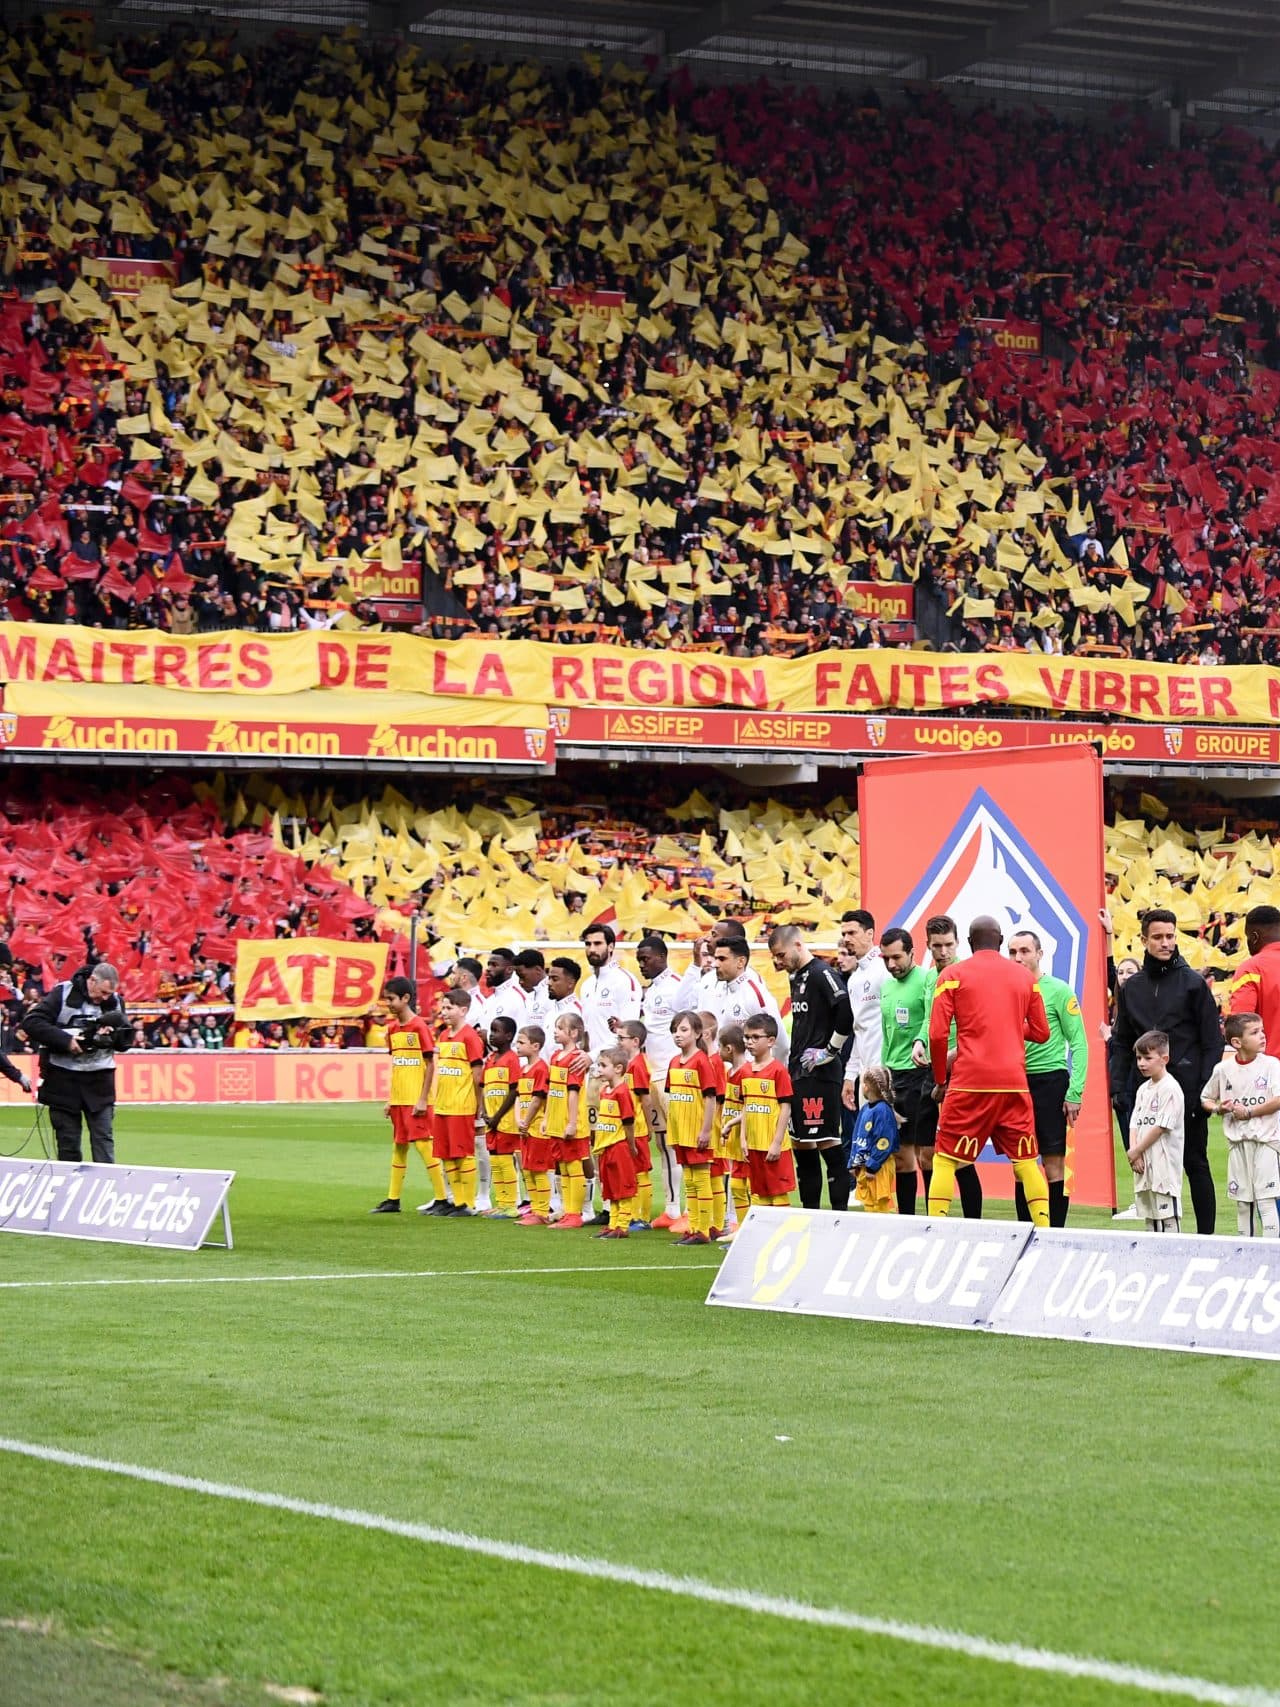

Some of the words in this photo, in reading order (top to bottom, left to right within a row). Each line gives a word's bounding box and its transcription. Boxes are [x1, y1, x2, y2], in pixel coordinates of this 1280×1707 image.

[994, 330, 1038, 349] chan
[0, 634, 272, 689] MAITRES
[317, 642, 392, 690] DE
[433, 651, 512, 698] LA
[815, 663, 1010, 706] FAITES
[1038, 667, 1239, 718] VIBRER
[42, 716, 178, 751] Auchan
[207, 720, 340, 755] Auchan
[367, 723, 497, 759] Auchan
[914, 724, 1002, 751] waigéo
[1195, 736, 1270, 757] GROUPE
[242, 954, 376, 1009] ATB
[116, 1063, 197, 1100] LENS
[296, 1063, 344, 1098] RC
[588, 1107, 597, 1124] 8
[651, 1109, 660, 1126] 2
[78, 1178, 143, 1228] Uber
[133, 1183, 200, 1233] Eats
[823, 1233, 1004, 1307] LIGUE
[1044, 1250, 1171, 1323] Uber
